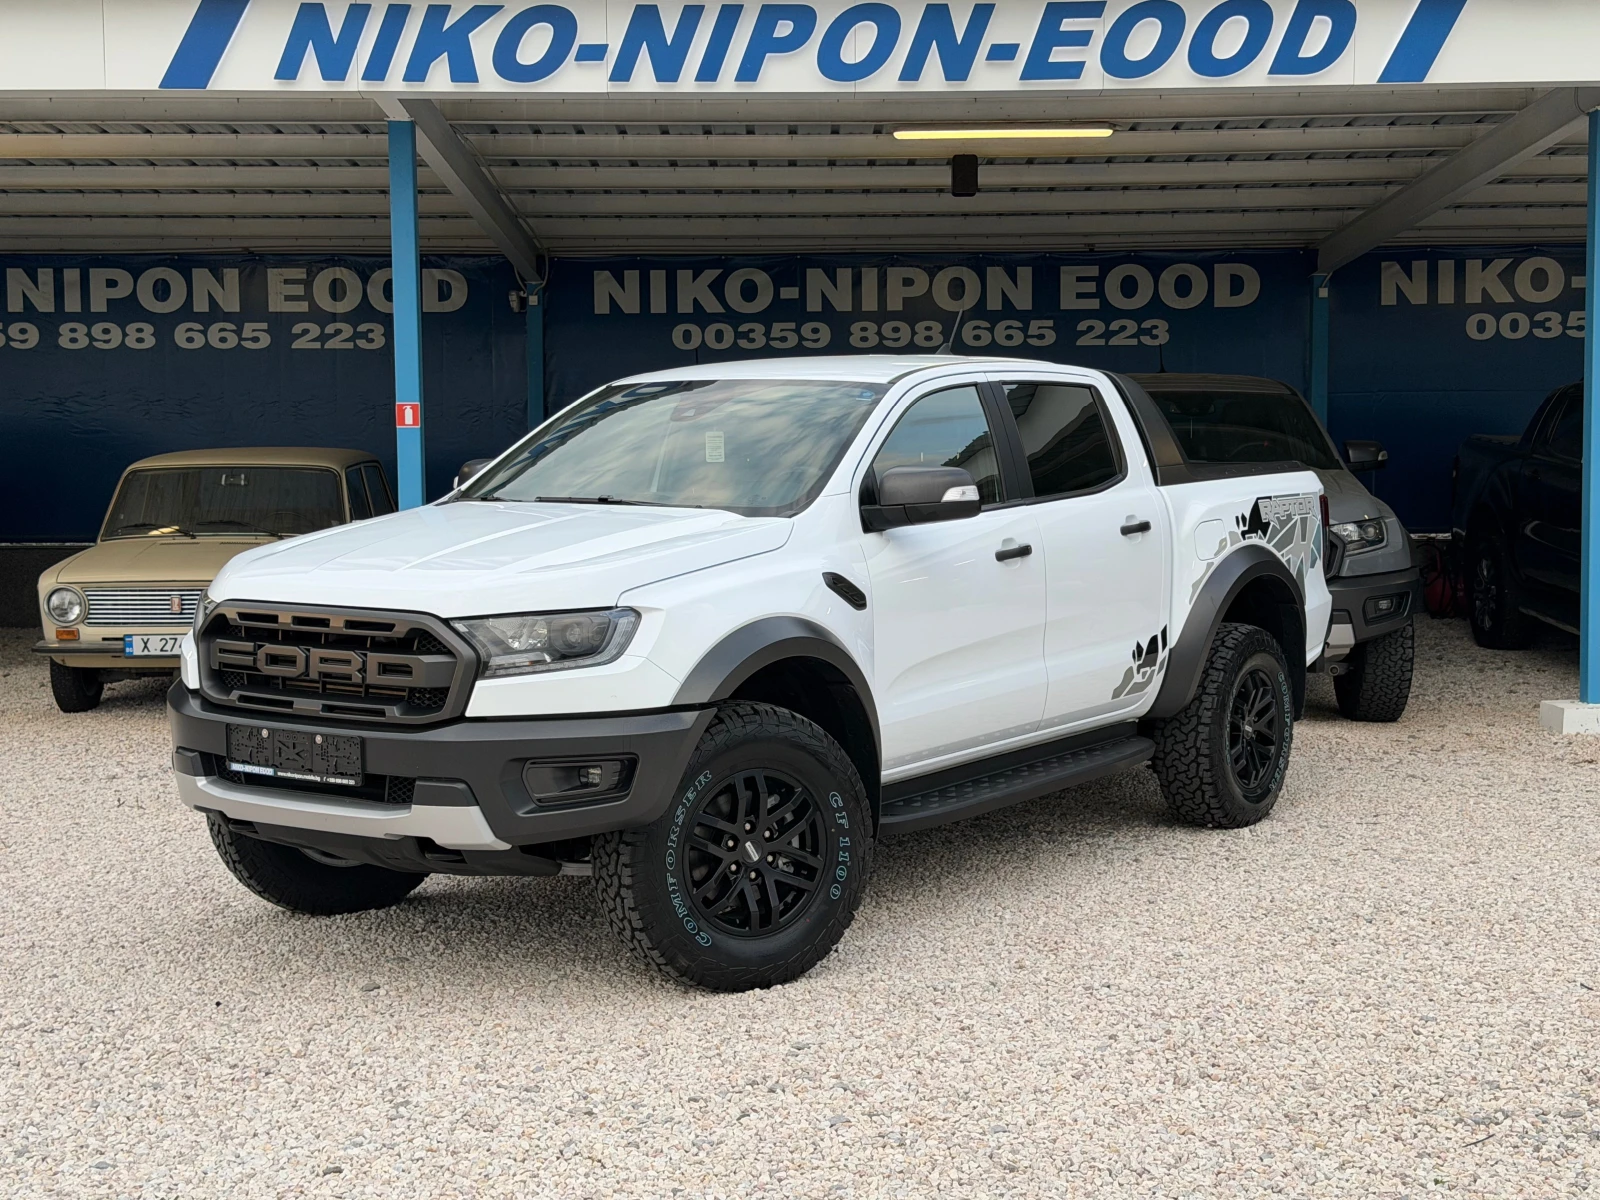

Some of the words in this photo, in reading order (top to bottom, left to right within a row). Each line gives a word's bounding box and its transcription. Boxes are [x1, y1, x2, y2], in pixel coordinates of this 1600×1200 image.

[273, 0, 1358, 84] NIKO-NIPON-EOOD
[6, 266, 241, 314] NIPON
[593, 265, 1033, 315] NIKO-NIPON
[1059, 262, 1261, 310] EOOD
[57, 321, 156, 350] 898
[173, 321, 272, 350] 665
[291, 322, 386, 350] 223
[671, 321, 832, 351] 00359
[848, 320, 944, 349] 898
[961, 319, 1056, 347] 665
[1075, 318, 1170, 346] 223
[1257, 497, 1317, 526] RAPTOR
[210, 638, 425, 687] FORD
[829, 791, 849, 828] CF
[665, 770, 712, 947] COMFORSER
[830, 836, 850, 900] 1100
